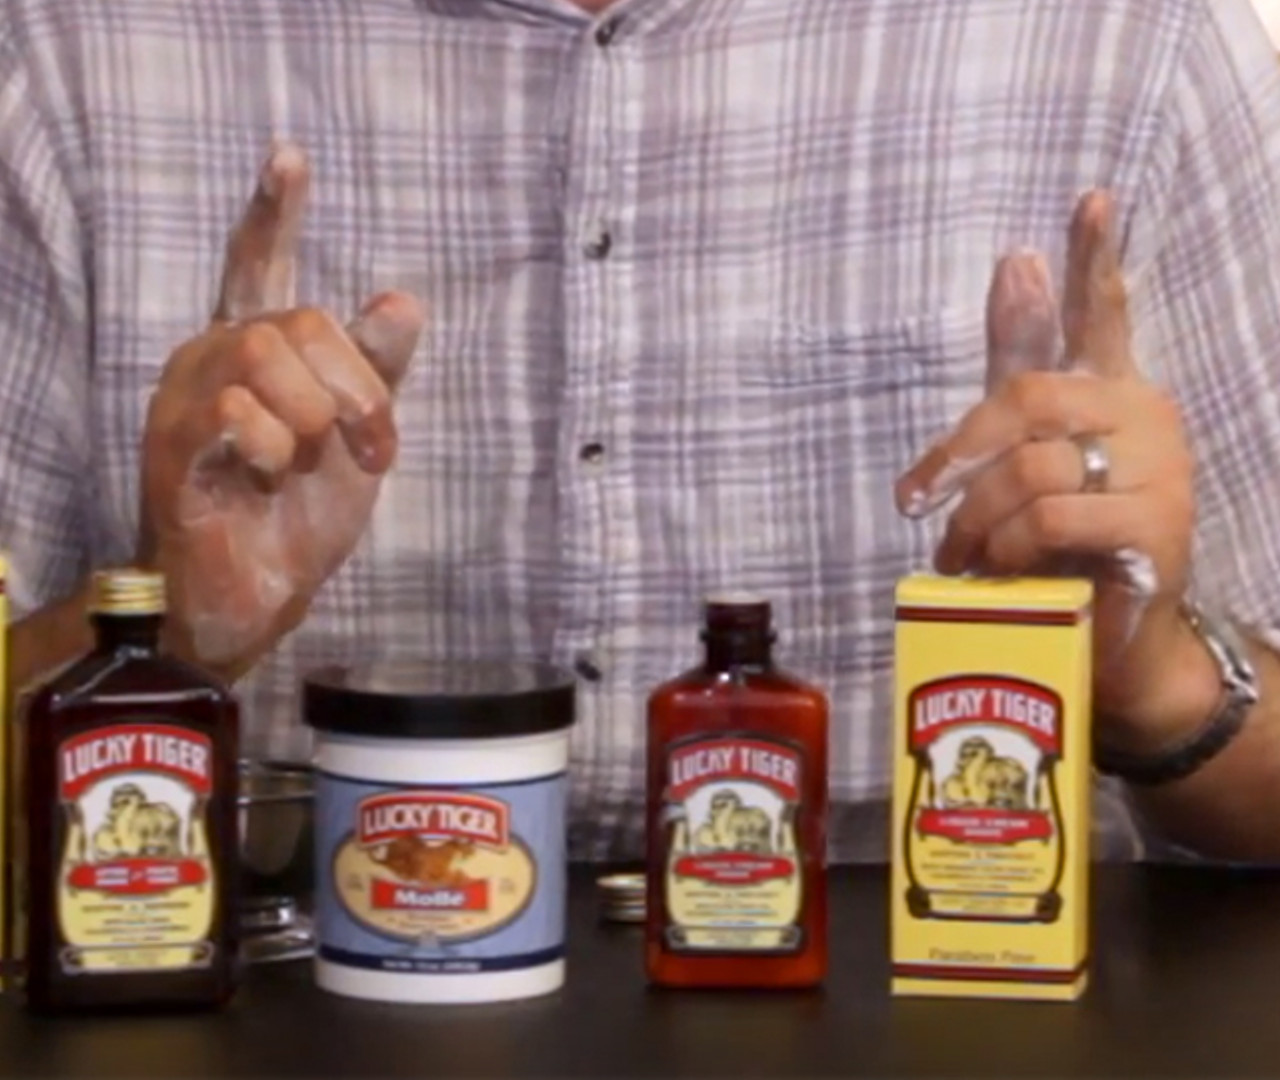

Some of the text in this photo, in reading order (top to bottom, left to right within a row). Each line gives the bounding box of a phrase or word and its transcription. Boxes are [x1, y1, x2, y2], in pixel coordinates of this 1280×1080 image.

[915, 688, 1055, 736] LUCKY TIGER
[64, 733, 208, 782] LUCKY TIGER
[672, 746, 797, 787] LUCKY TIGER
[364, 803, 499, 836] LUCKY TIGER
